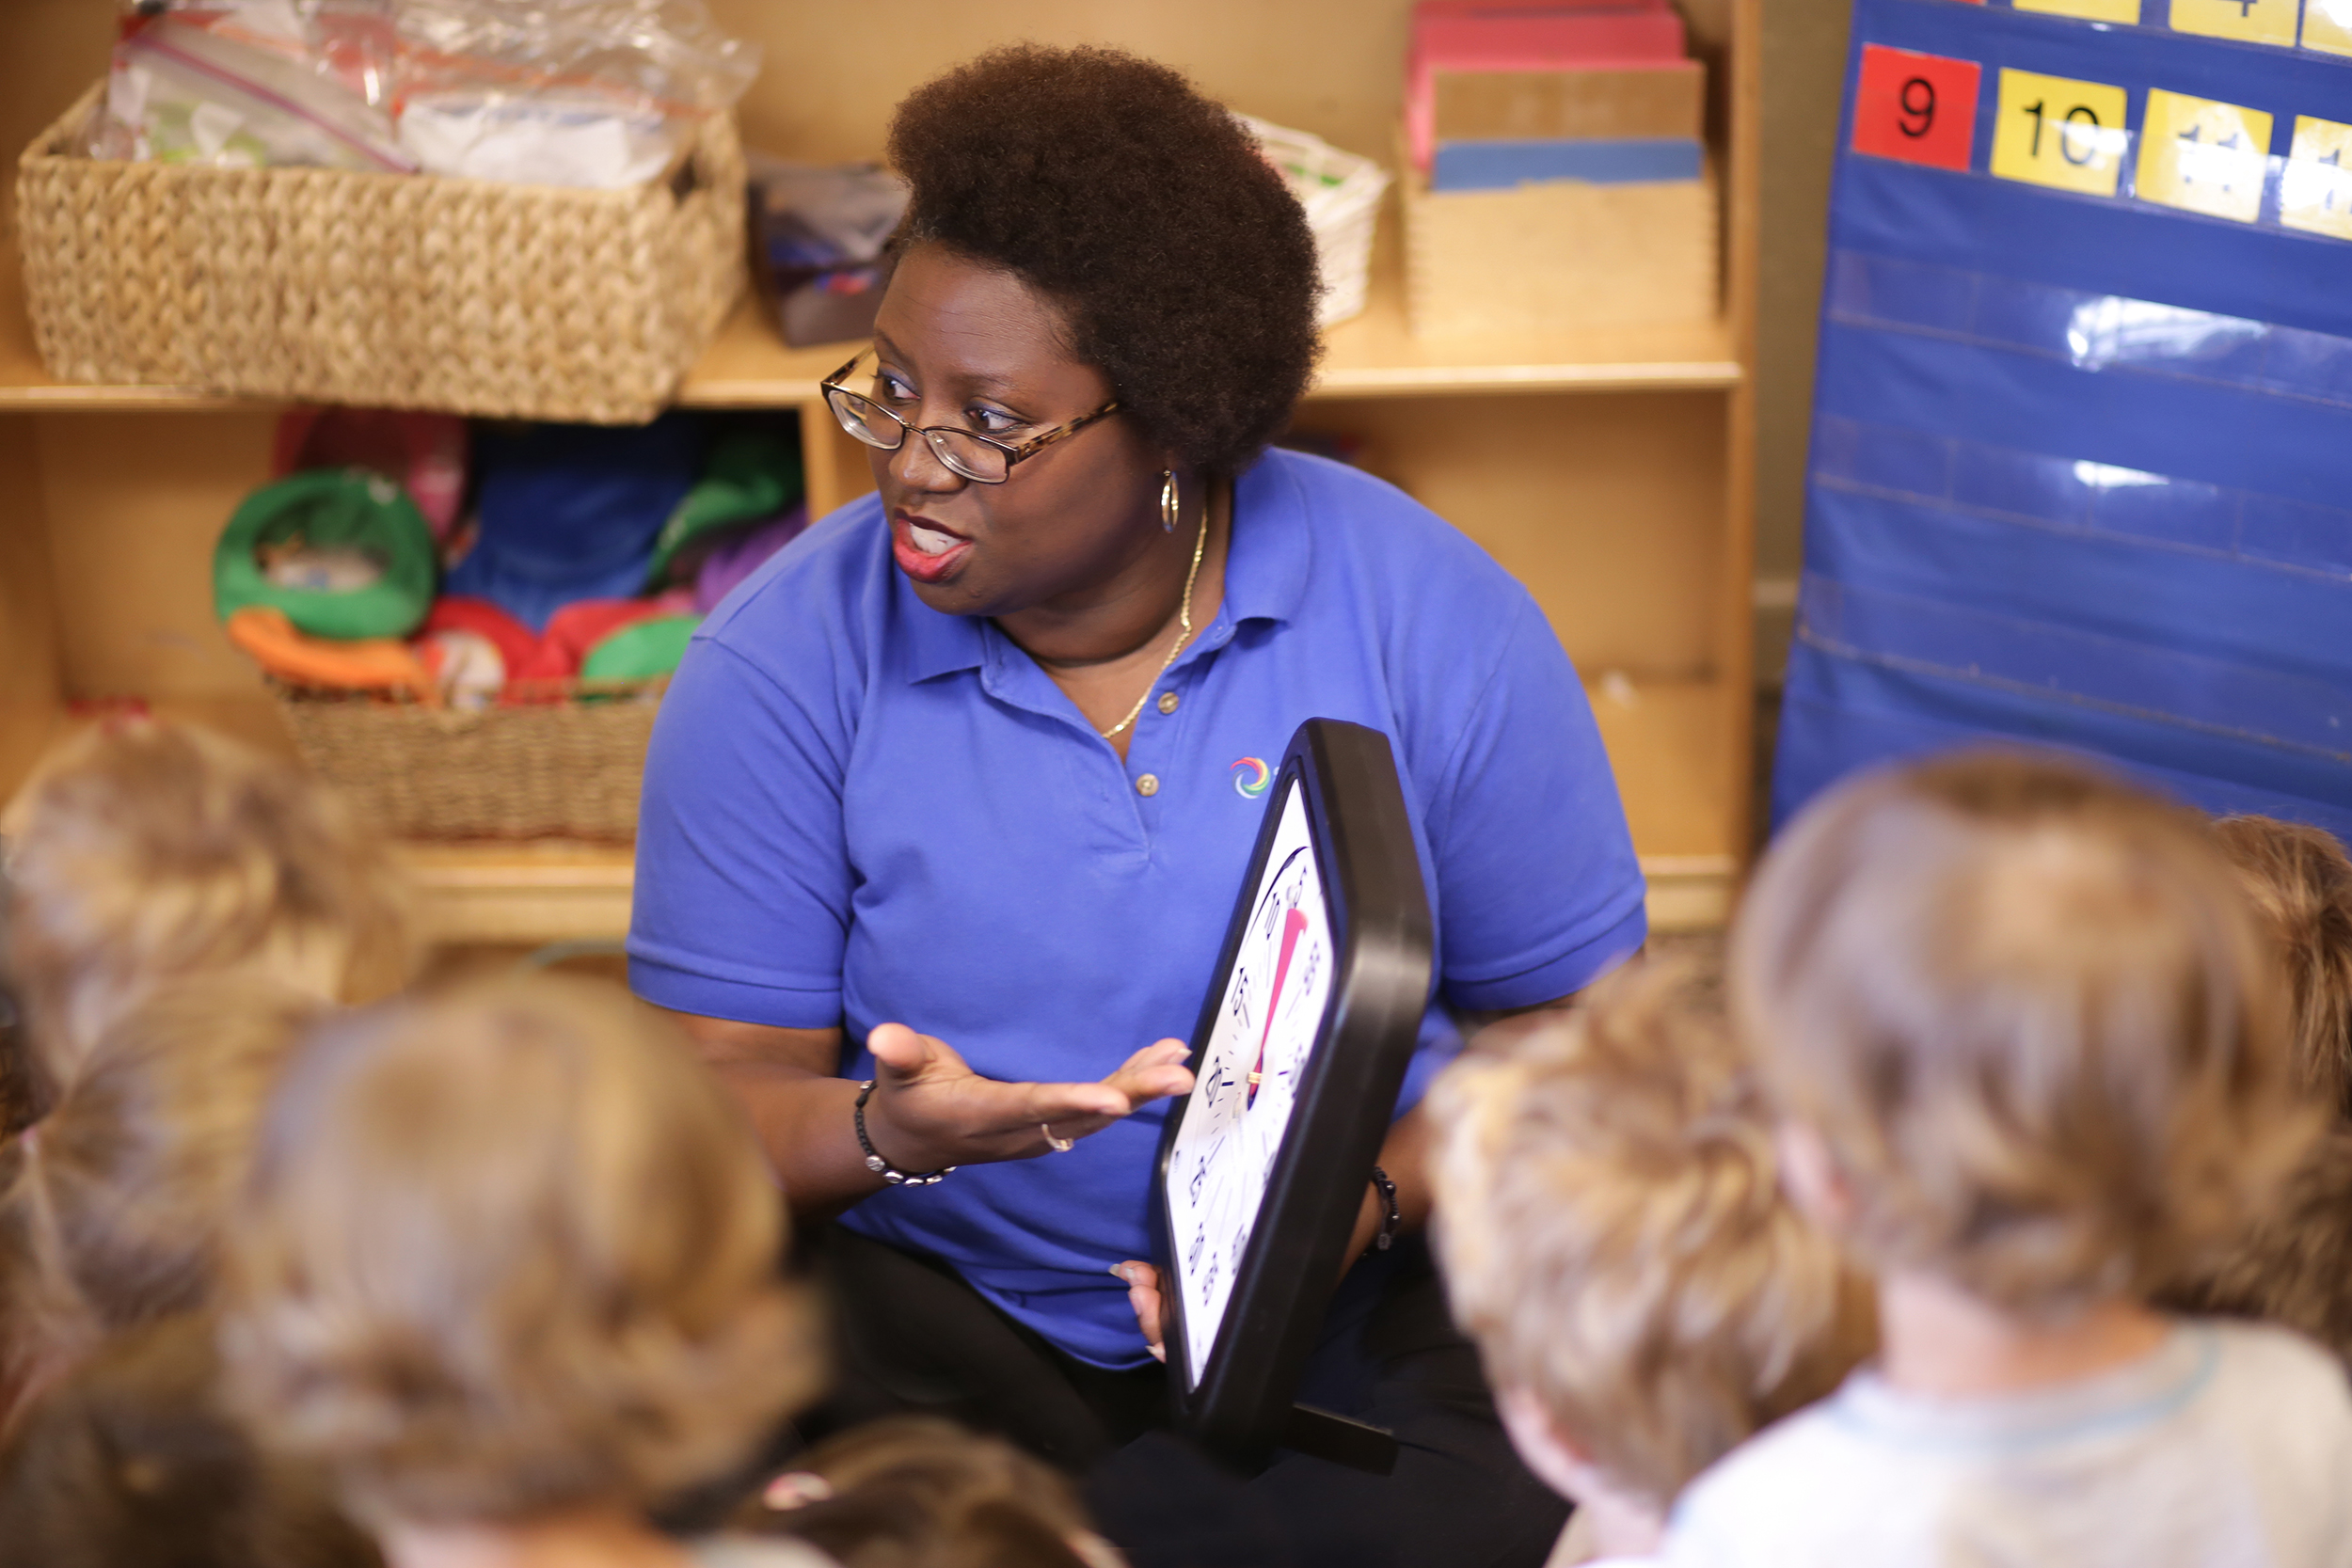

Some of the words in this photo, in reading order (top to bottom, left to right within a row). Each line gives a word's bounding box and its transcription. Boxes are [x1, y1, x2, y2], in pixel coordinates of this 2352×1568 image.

[1897, 75, 1937, 138] 9
[2021, 98, 2100, 166] 10
[1231, 967, 1249, 1017] 15
